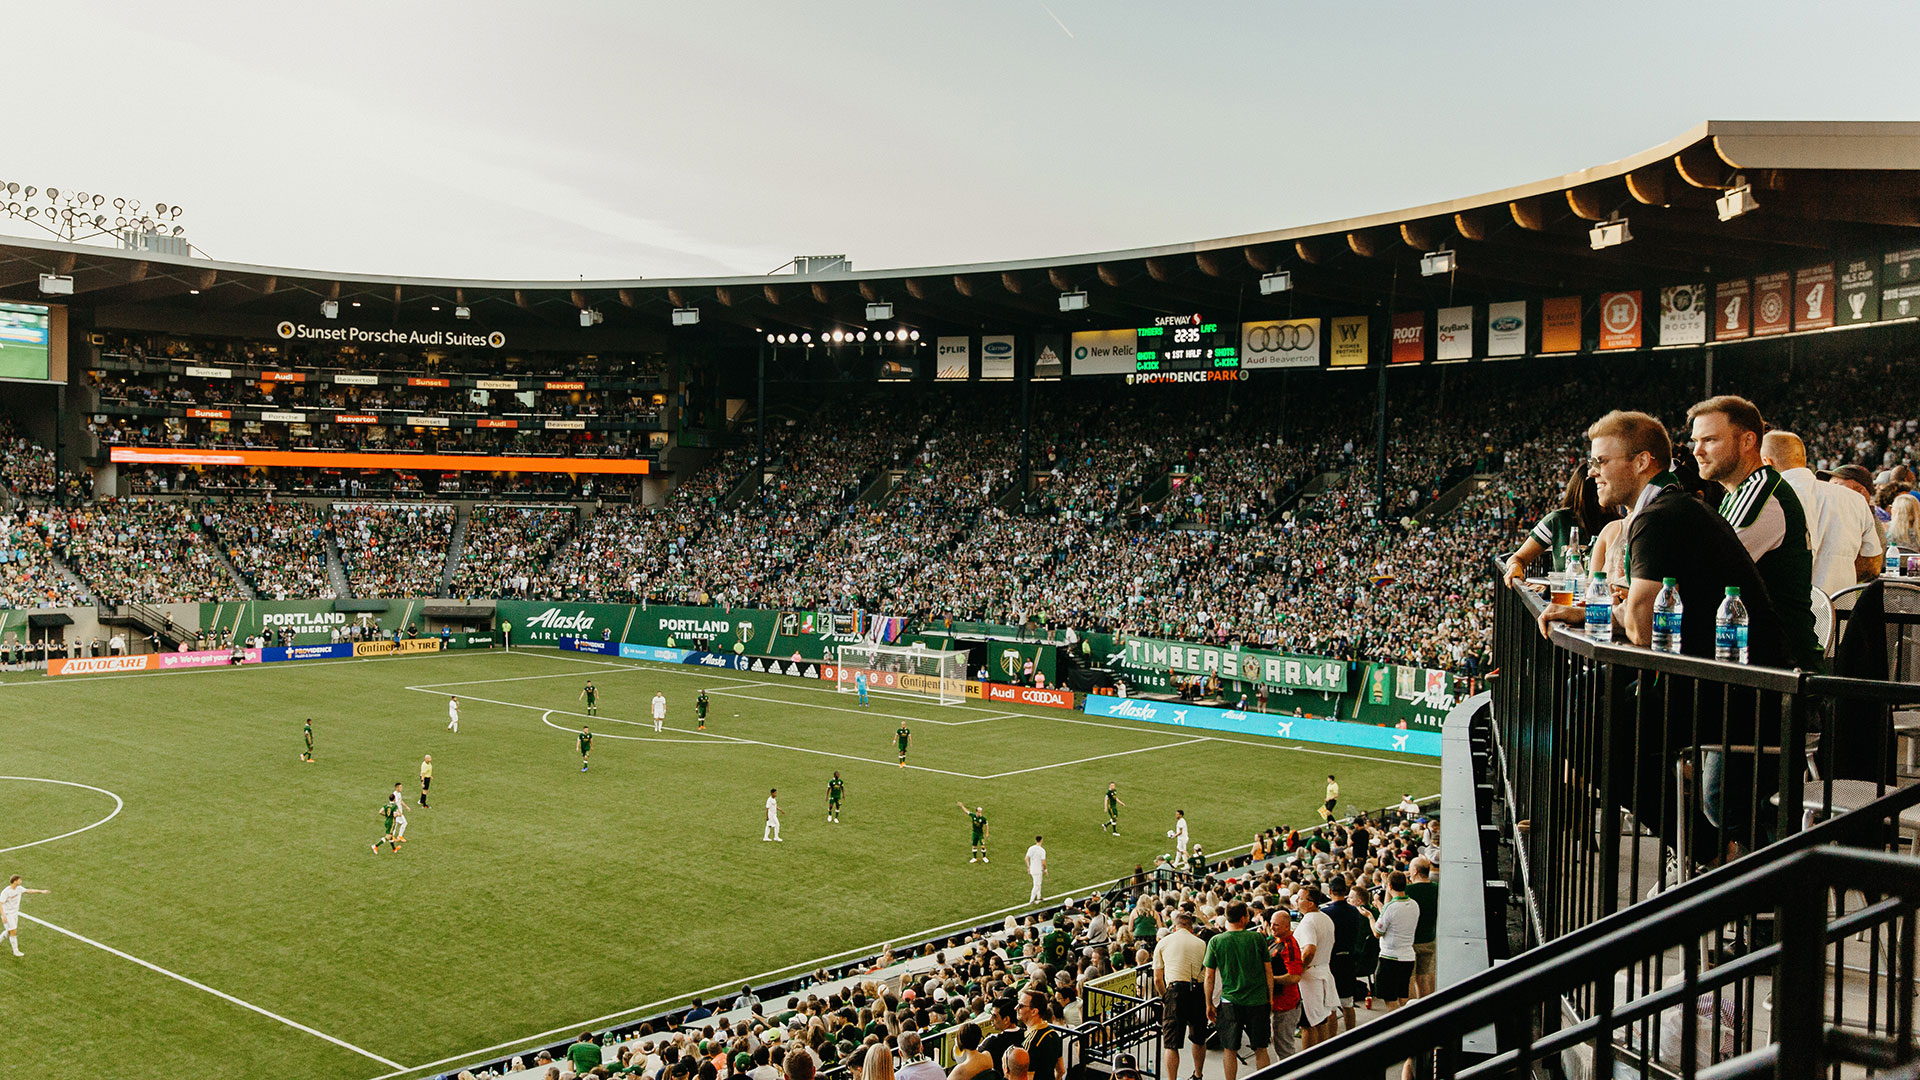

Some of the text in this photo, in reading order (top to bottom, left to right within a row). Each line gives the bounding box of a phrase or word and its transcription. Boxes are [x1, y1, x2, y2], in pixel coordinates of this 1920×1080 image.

[1155, 315, 1191, 326] SAFEWAY
[1669, 312, 1696, 321] WILD
[1200, 324, 1217, 333] LAFC
[1439, 323, 1470, 333] KeyBank
[1495, 319, 1517, 331] Ford
[1664, 322, 1701, 331] ROOTS
[297, 324, 487, 346] Sunset Porsche Audi Suites
[1137, 327, 1163, 336] TIMBERS
[1174, 328, 1200, 343] 22:35
[1393, 326, 1423, 340] ROOT
[946, 345, 966, 353] FLIR
[1091, 346, 1110, 357] New
[1172, 349, 1202, 359] 1ST HALF
[1214, 347, 1235, 357] SHOTS
[1137, 351, 1156, 360] SHOTS
[1246, 354, 1315, 364] Audi Beaverton
[195, 368, 222, 376] Sunset
[1136, 370, 1238, 384] PROVIDENCE PARK
[195, 410, 223, 418] Sunset
[262, 613, 345, 626] PORTLAND
[526, 607, 595, 632] Alaska
[281, 625, 331, 633] TMBERS
[659, 618, 729, 633] PORTLAND
[674, 632, 717, 641] TIMBERS
[294, 646, 332, 654] PROVIDENCE
[357, 641, 437, 656] Continenal TIRE
[65, 658, 146, 671] ADVOCARE
[700, 653, 726, 667] Alaska
[1128, 640, 1238, 677] TIMBERS
[1265, 658, 1341, 688] ARMY
[959, 684, 979, 694] TIRE
[990, 687, 1015, 699] Audi
[1109, 699, 1157, 721] Alaska
